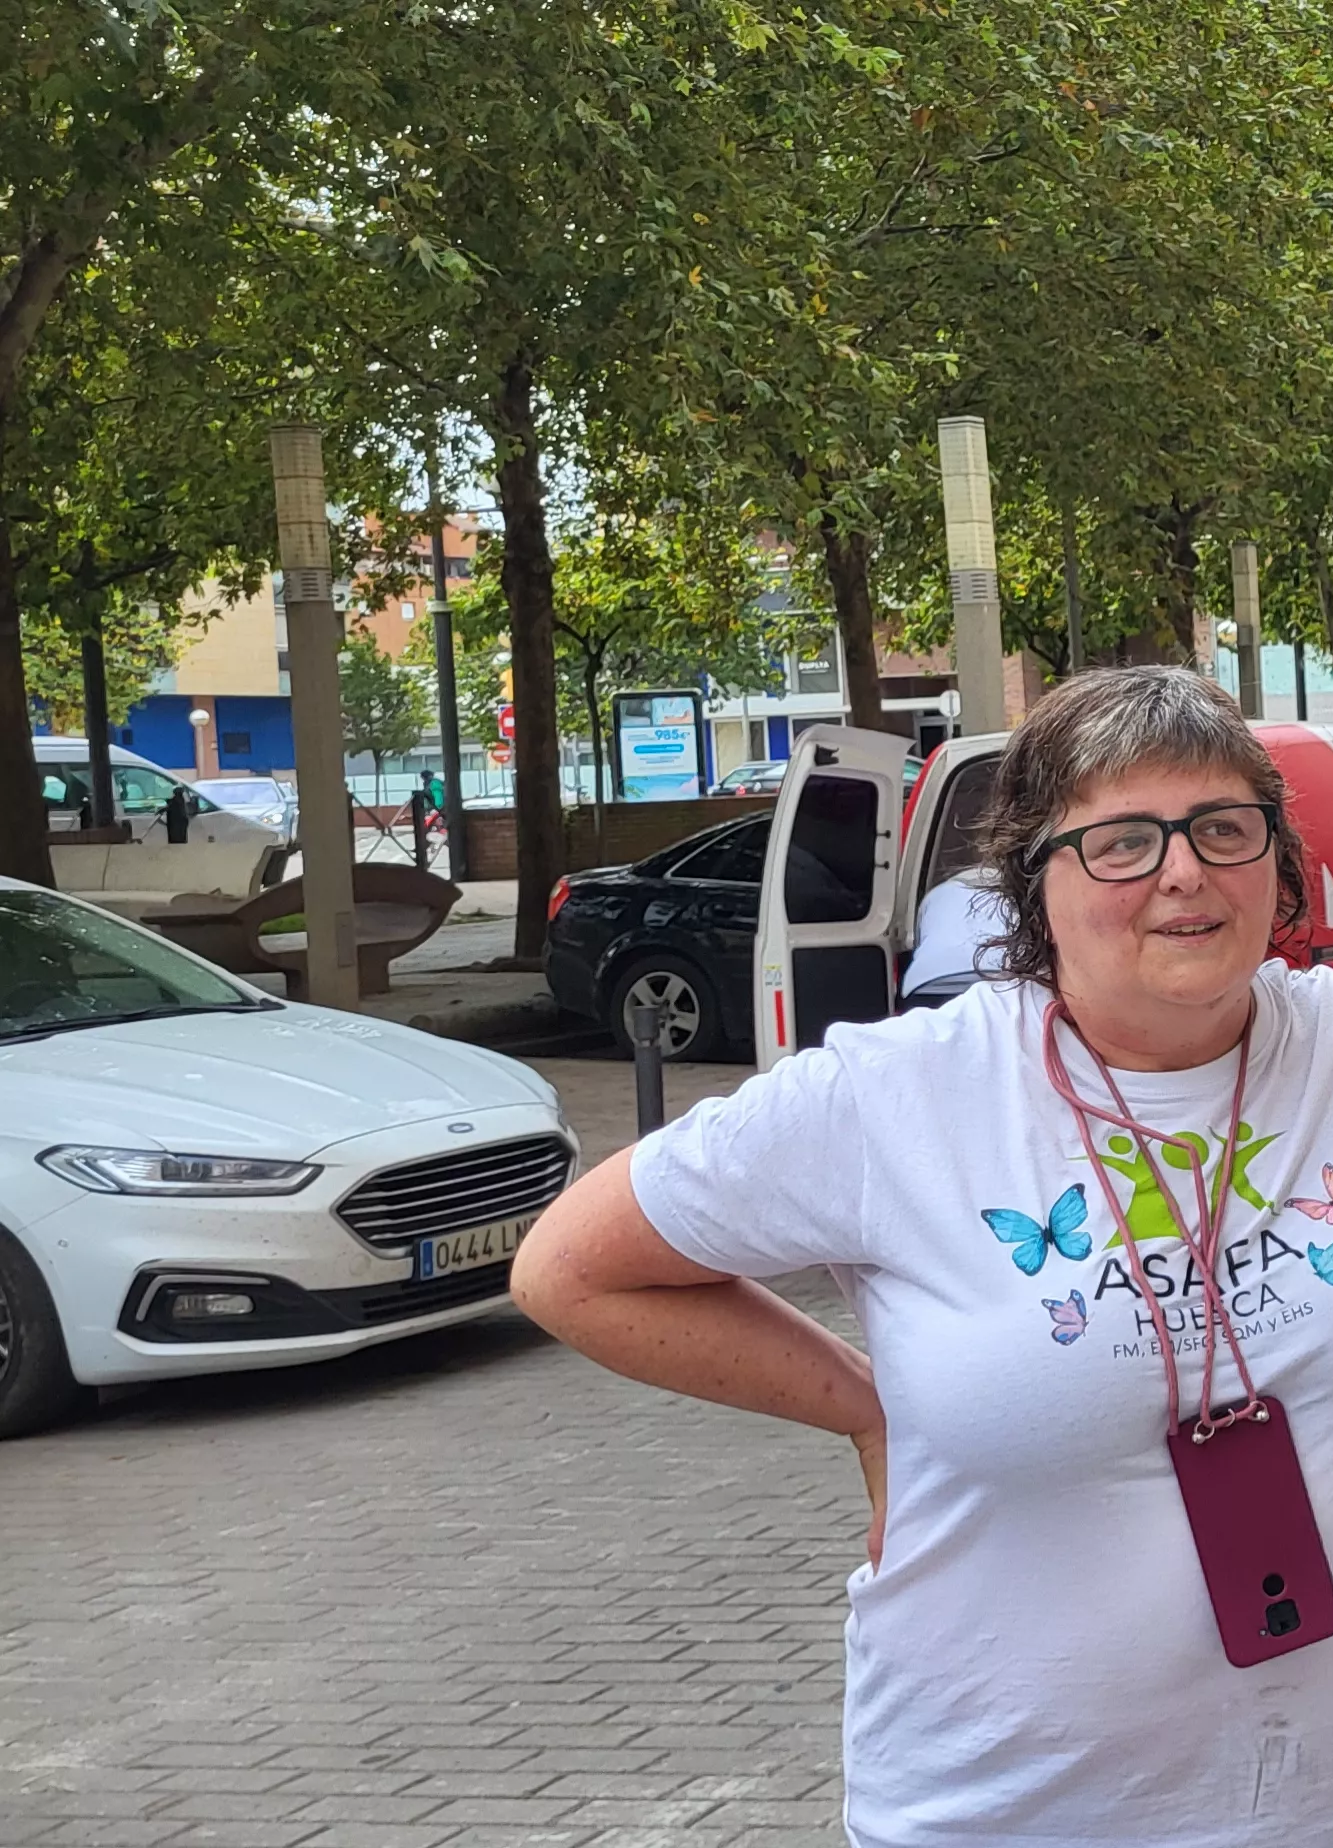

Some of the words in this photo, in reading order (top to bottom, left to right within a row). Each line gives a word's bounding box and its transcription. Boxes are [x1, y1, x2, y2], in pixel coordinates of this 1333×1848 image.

[436, 1228, 493, 1270] 0444
[1113, 1341, 1146, 1359] FM,
[1282, 1302, 1314, 1325] EHS
